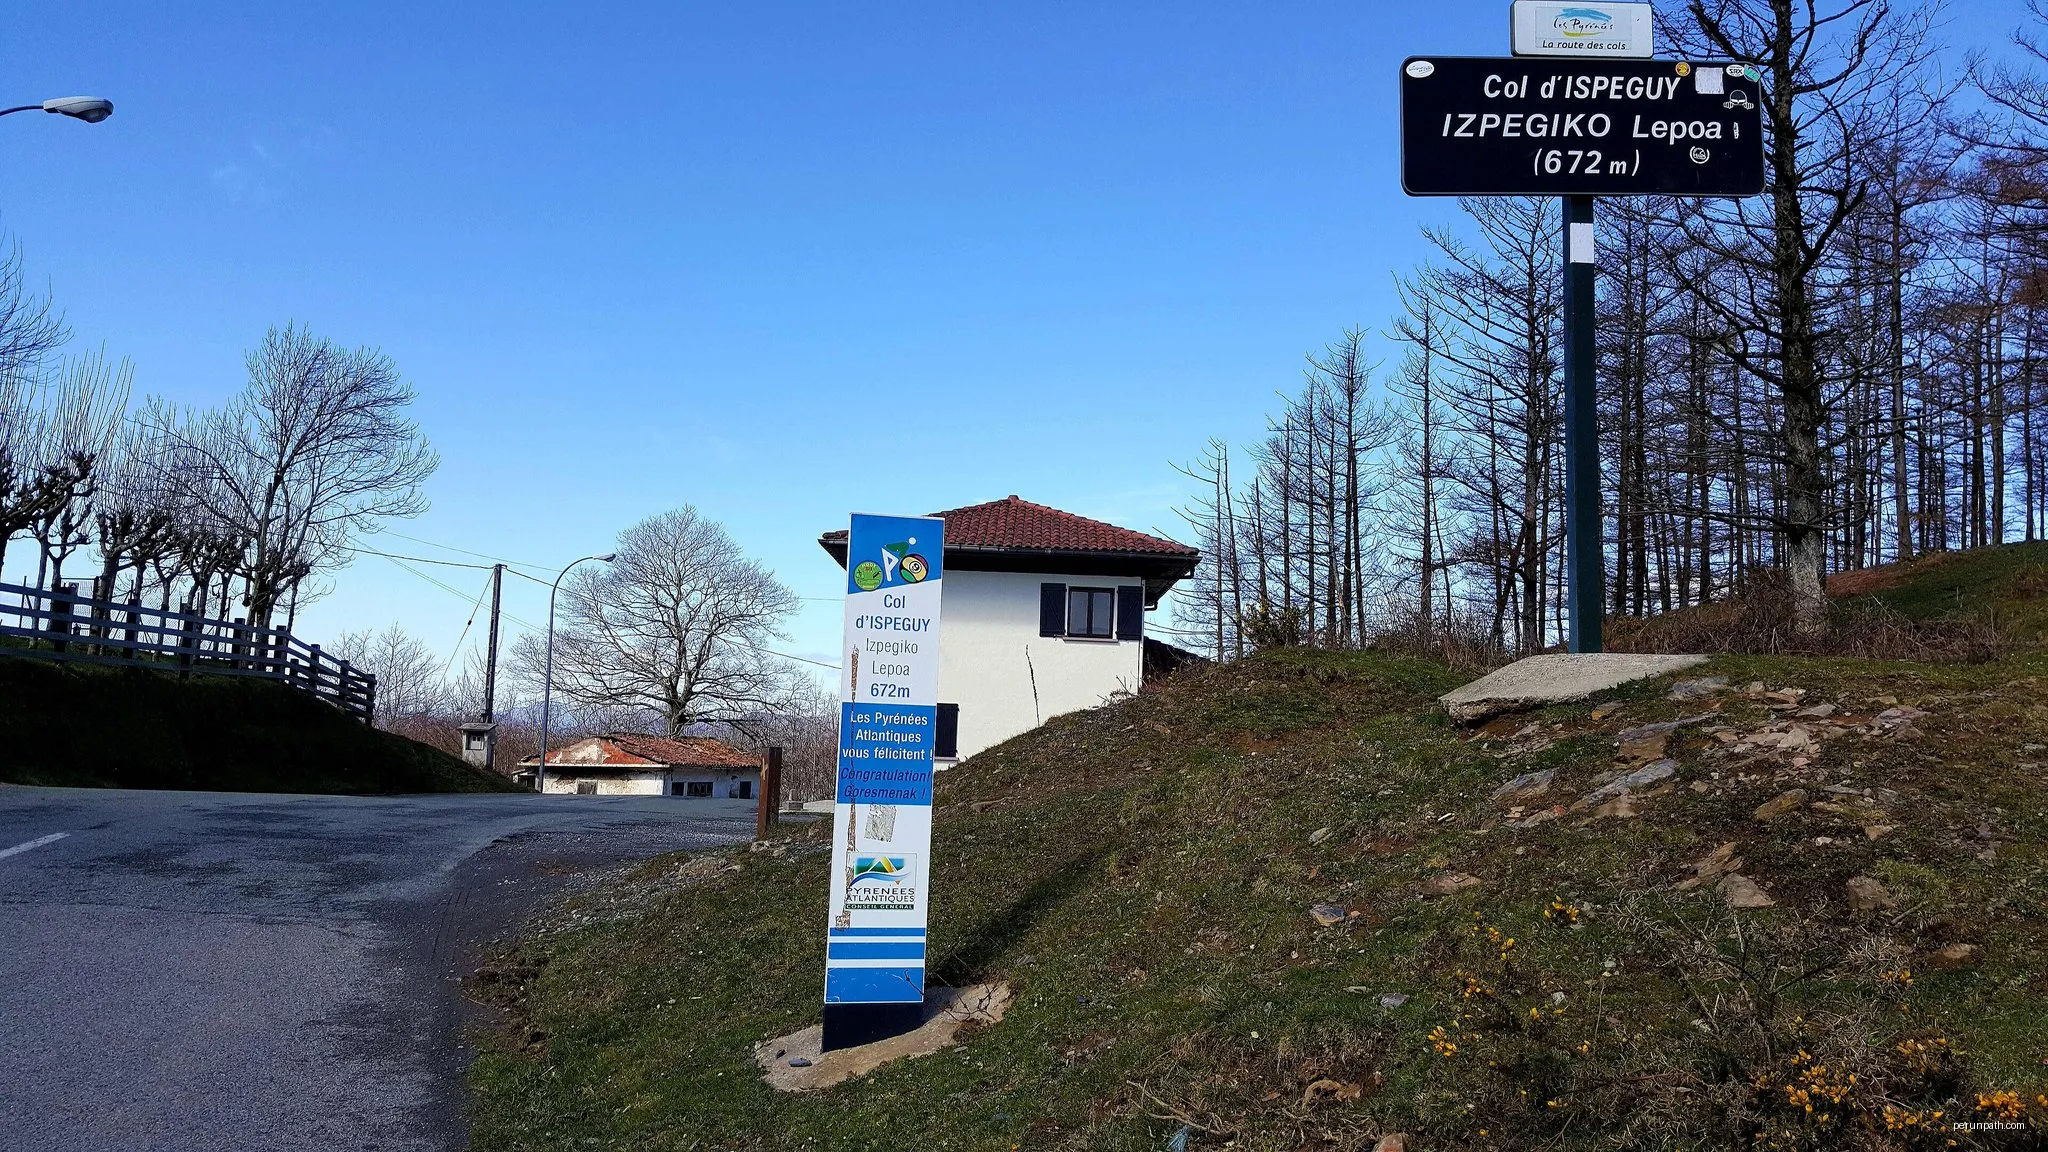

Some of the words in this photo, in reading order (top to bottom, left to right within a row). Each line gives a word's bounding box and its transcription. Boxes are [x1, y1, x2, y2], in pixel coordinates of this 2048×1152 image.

[1542, 40, 1554, 48] La
[1557, 41, 1584, 49] route
[1587, 41, 1604, 50] des
[1606, 42, 1626, 50] cols
[1483, 74, 1528, 99] Col
[1540, 75, 1681, 100] d'ISPEGUY
[1442, 113, 1611, 138] IZPEGIKO
[1632, 115, 1722, 145] Lepoa
[1534, 149, 1602, 176] (672
[1609, 150, 1640, 177] m)
[883, 594, 906, 609] Col
[855, 615, 930, 632] d’ISPEGUY
[866, 638, 918, 656] Izpegiko
[872, 660, 910, 677] Lepoa
[870, 683, 910, 698] 672m
[851, 711, 870, 723] Les
[875, 712, 928, 727] Pyrénées
[856, 729, 921, 744] Atlantiques
[842, 749, 868, 759] vous
[874, 748, 925, 761] félicitent
[841, 767, 931, 783] Congratulation!
[844, 785, 917, 800] Goresmenak
[846, 895, 915, 903] ATLANTIQUES
